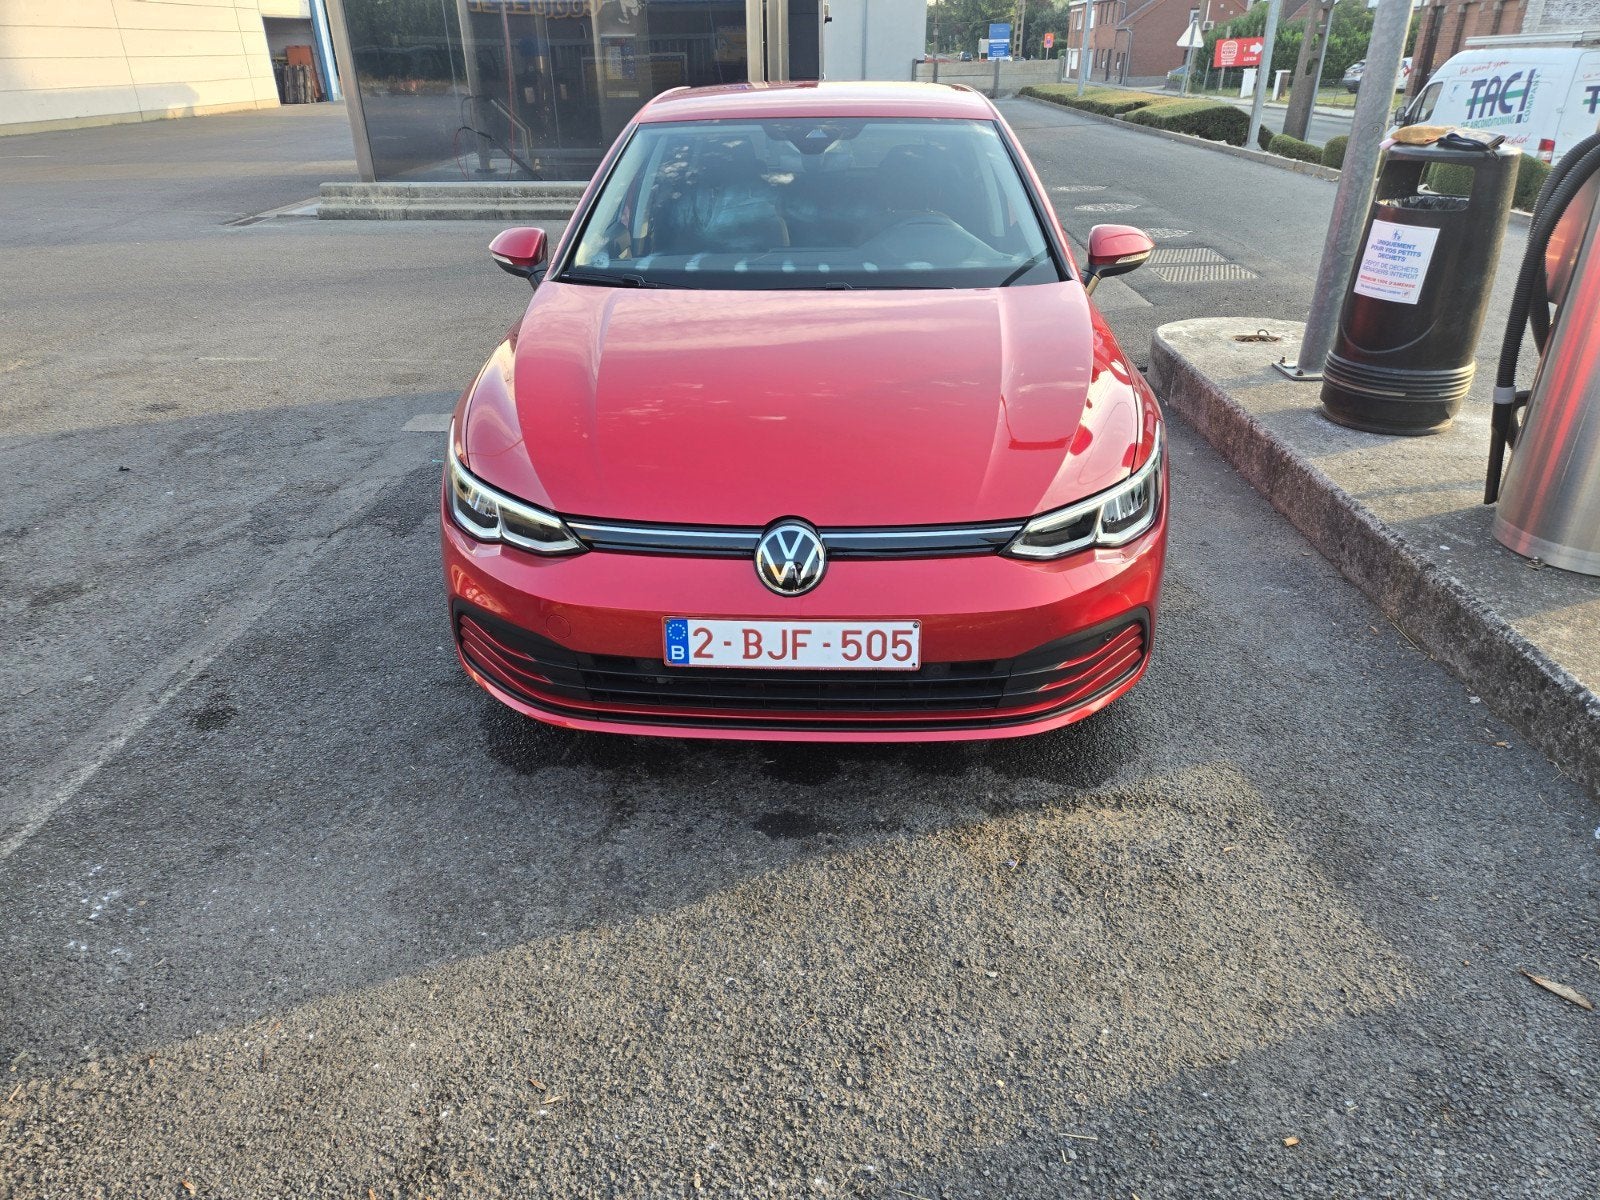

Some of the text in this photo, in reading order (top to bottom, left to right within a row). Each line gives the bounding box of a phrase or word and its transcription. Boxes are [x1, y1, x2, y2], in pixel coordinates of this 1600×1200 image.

[1522, 72, 1541, 123] COMPANY
[1397, 249, 1422, 258] PETITS
[671, 645, 685, 661] B
